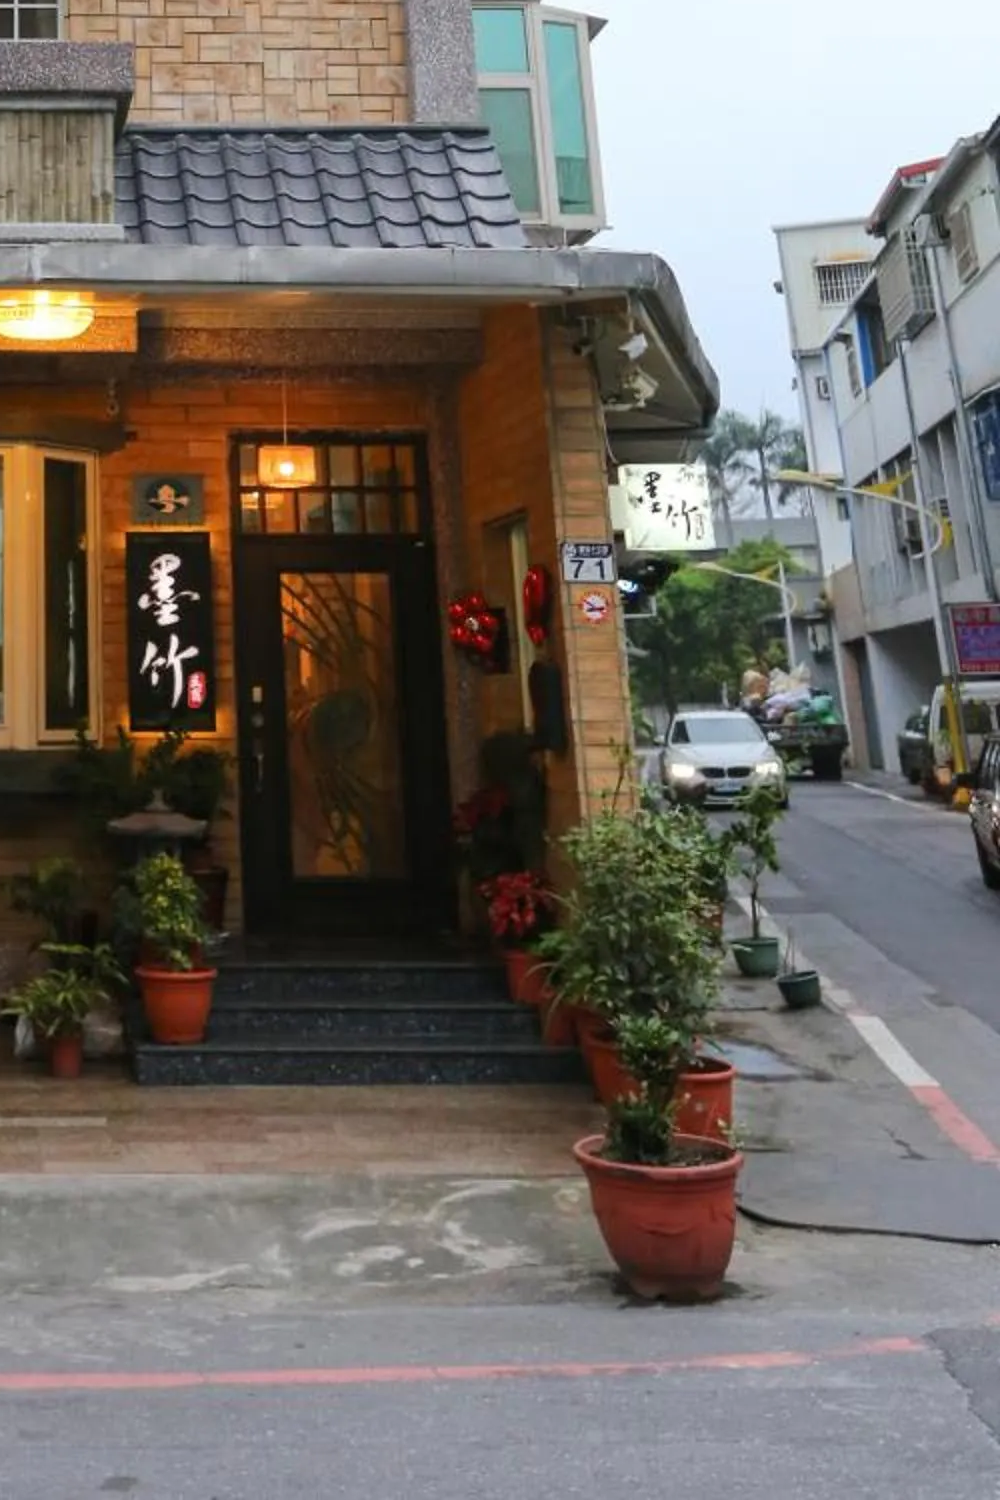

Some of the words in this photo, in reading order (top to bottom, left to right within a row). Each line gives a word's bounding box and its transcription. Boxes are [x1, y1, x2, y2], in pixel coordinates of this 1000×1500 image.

[635, 471, 699, 541] 墨竹
[569, 559, 606, 580] 71
[137, 553, 201, 709] 墨竹
